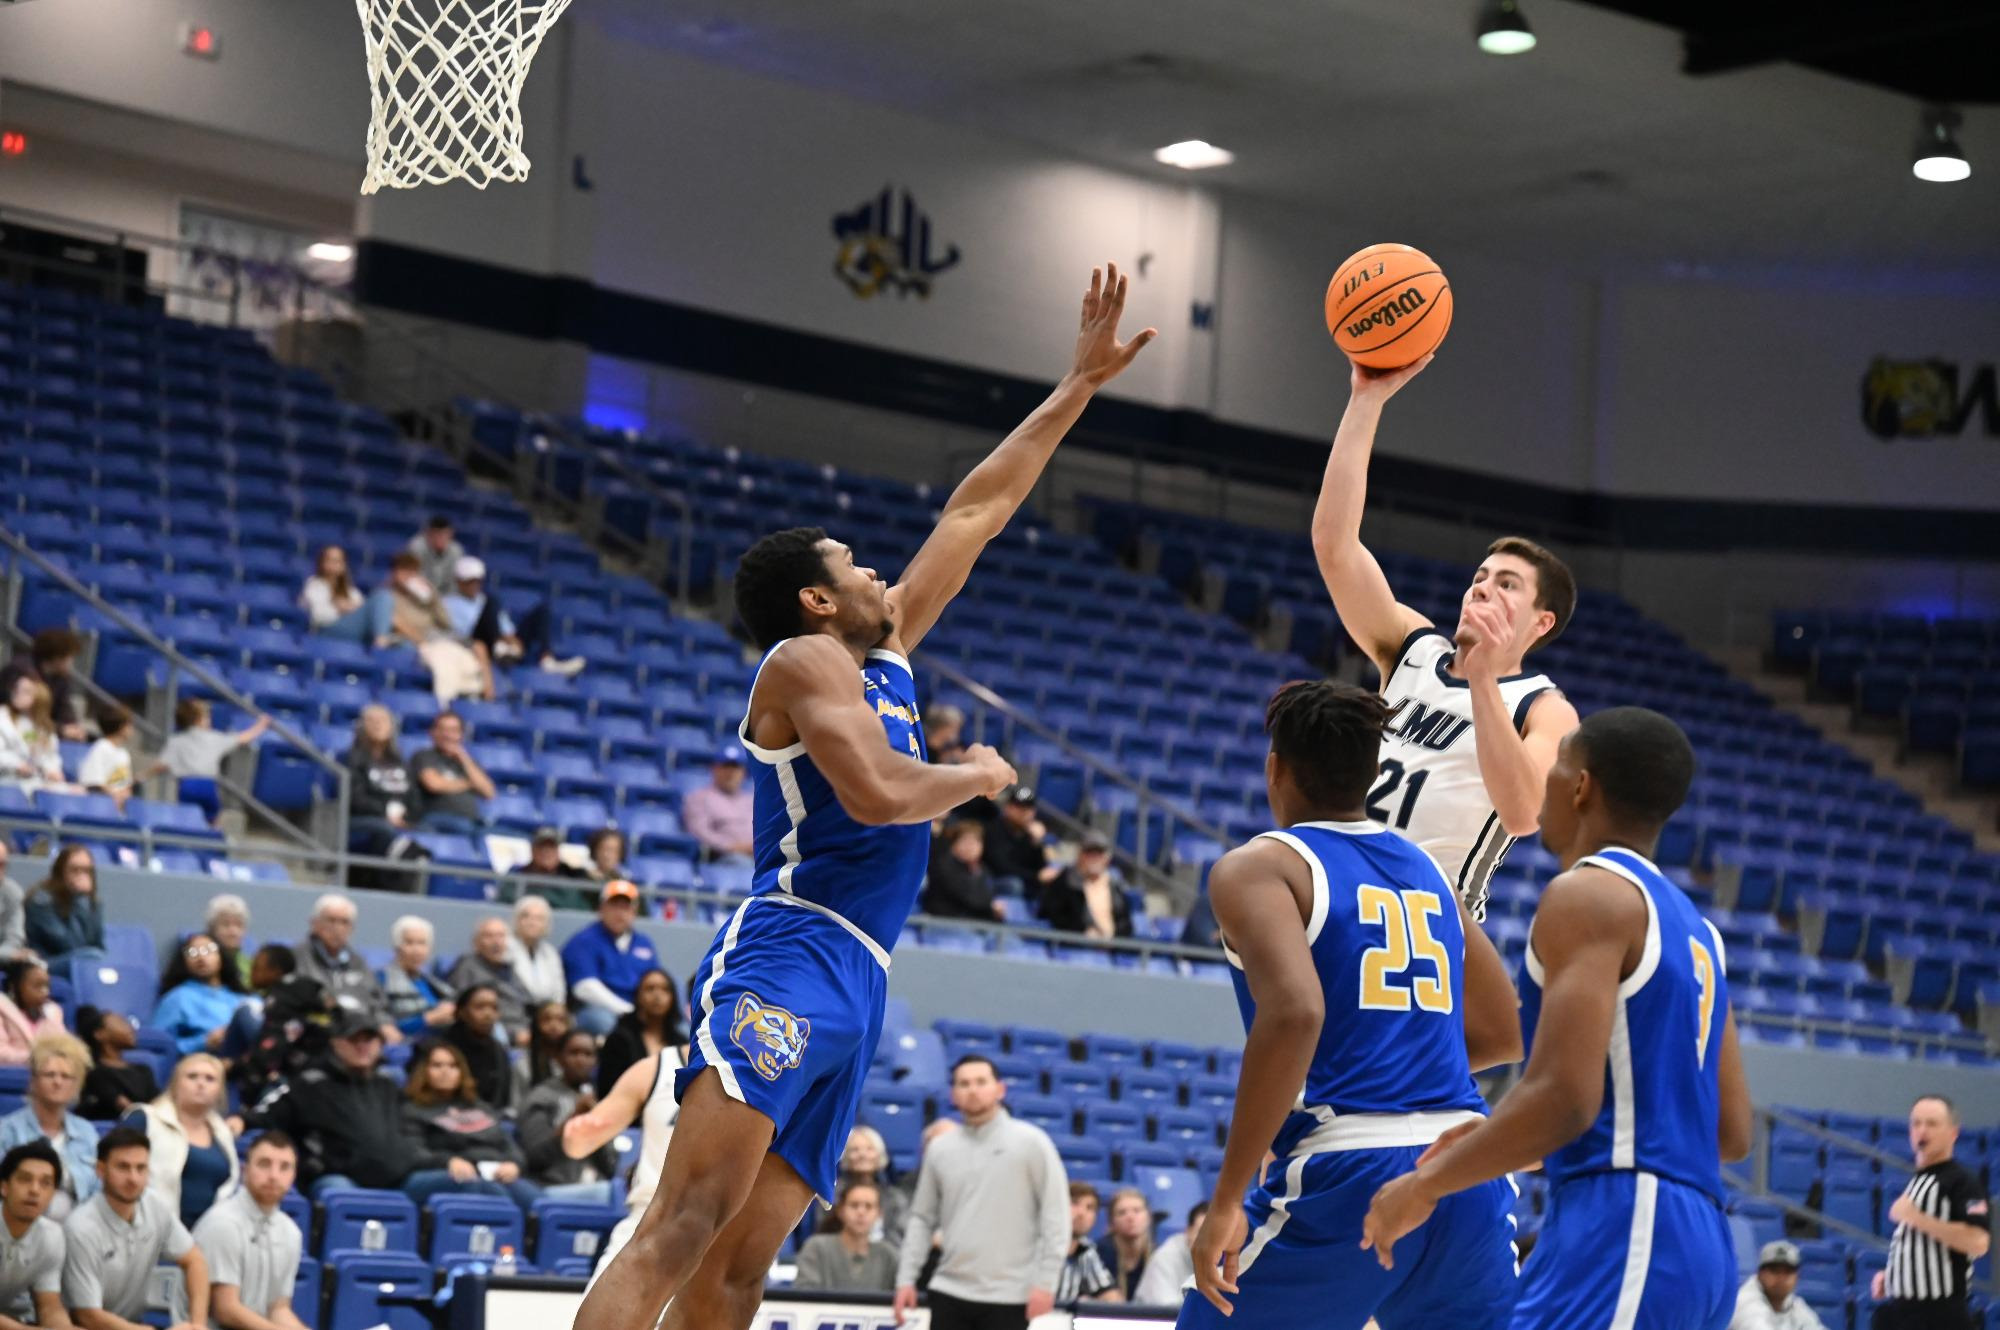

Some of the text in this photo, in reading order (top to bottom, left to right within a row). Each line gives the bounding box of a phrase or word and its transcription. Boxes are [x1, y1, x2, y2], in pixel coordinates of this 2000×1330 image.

[1346, 287, 1426, 338] Wilson
[1365, 757, 1430, 830] 21
[1357, 883, 1453, 1016] 25
